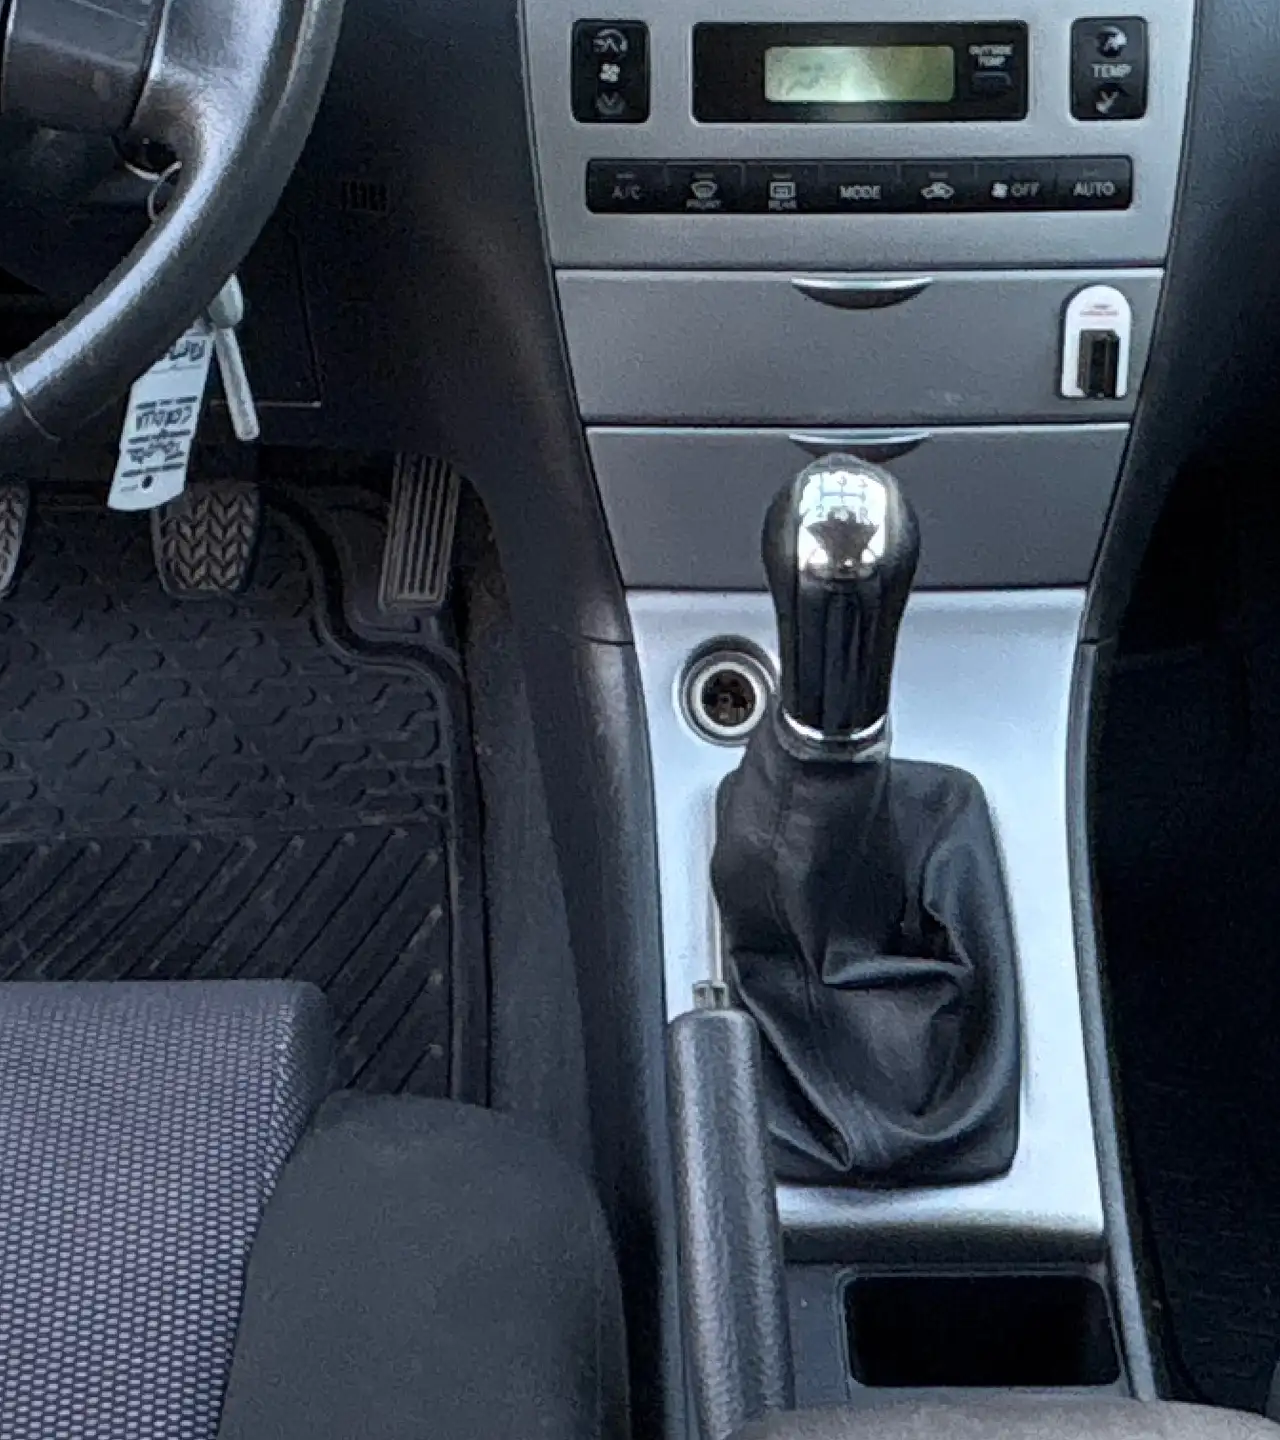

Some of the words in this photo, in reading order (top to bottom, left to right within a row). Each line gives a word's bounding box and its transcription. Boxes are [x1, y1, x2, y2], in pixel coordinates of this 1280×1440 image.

[1091, 63, 1133, 78] TEMP
[612, 185, 641, 200] A/C
[840, 184, 881, 200] MODE
[1010, 181, 1040, 197] OFF
[1072, 180, 1116, 197] AUTO
